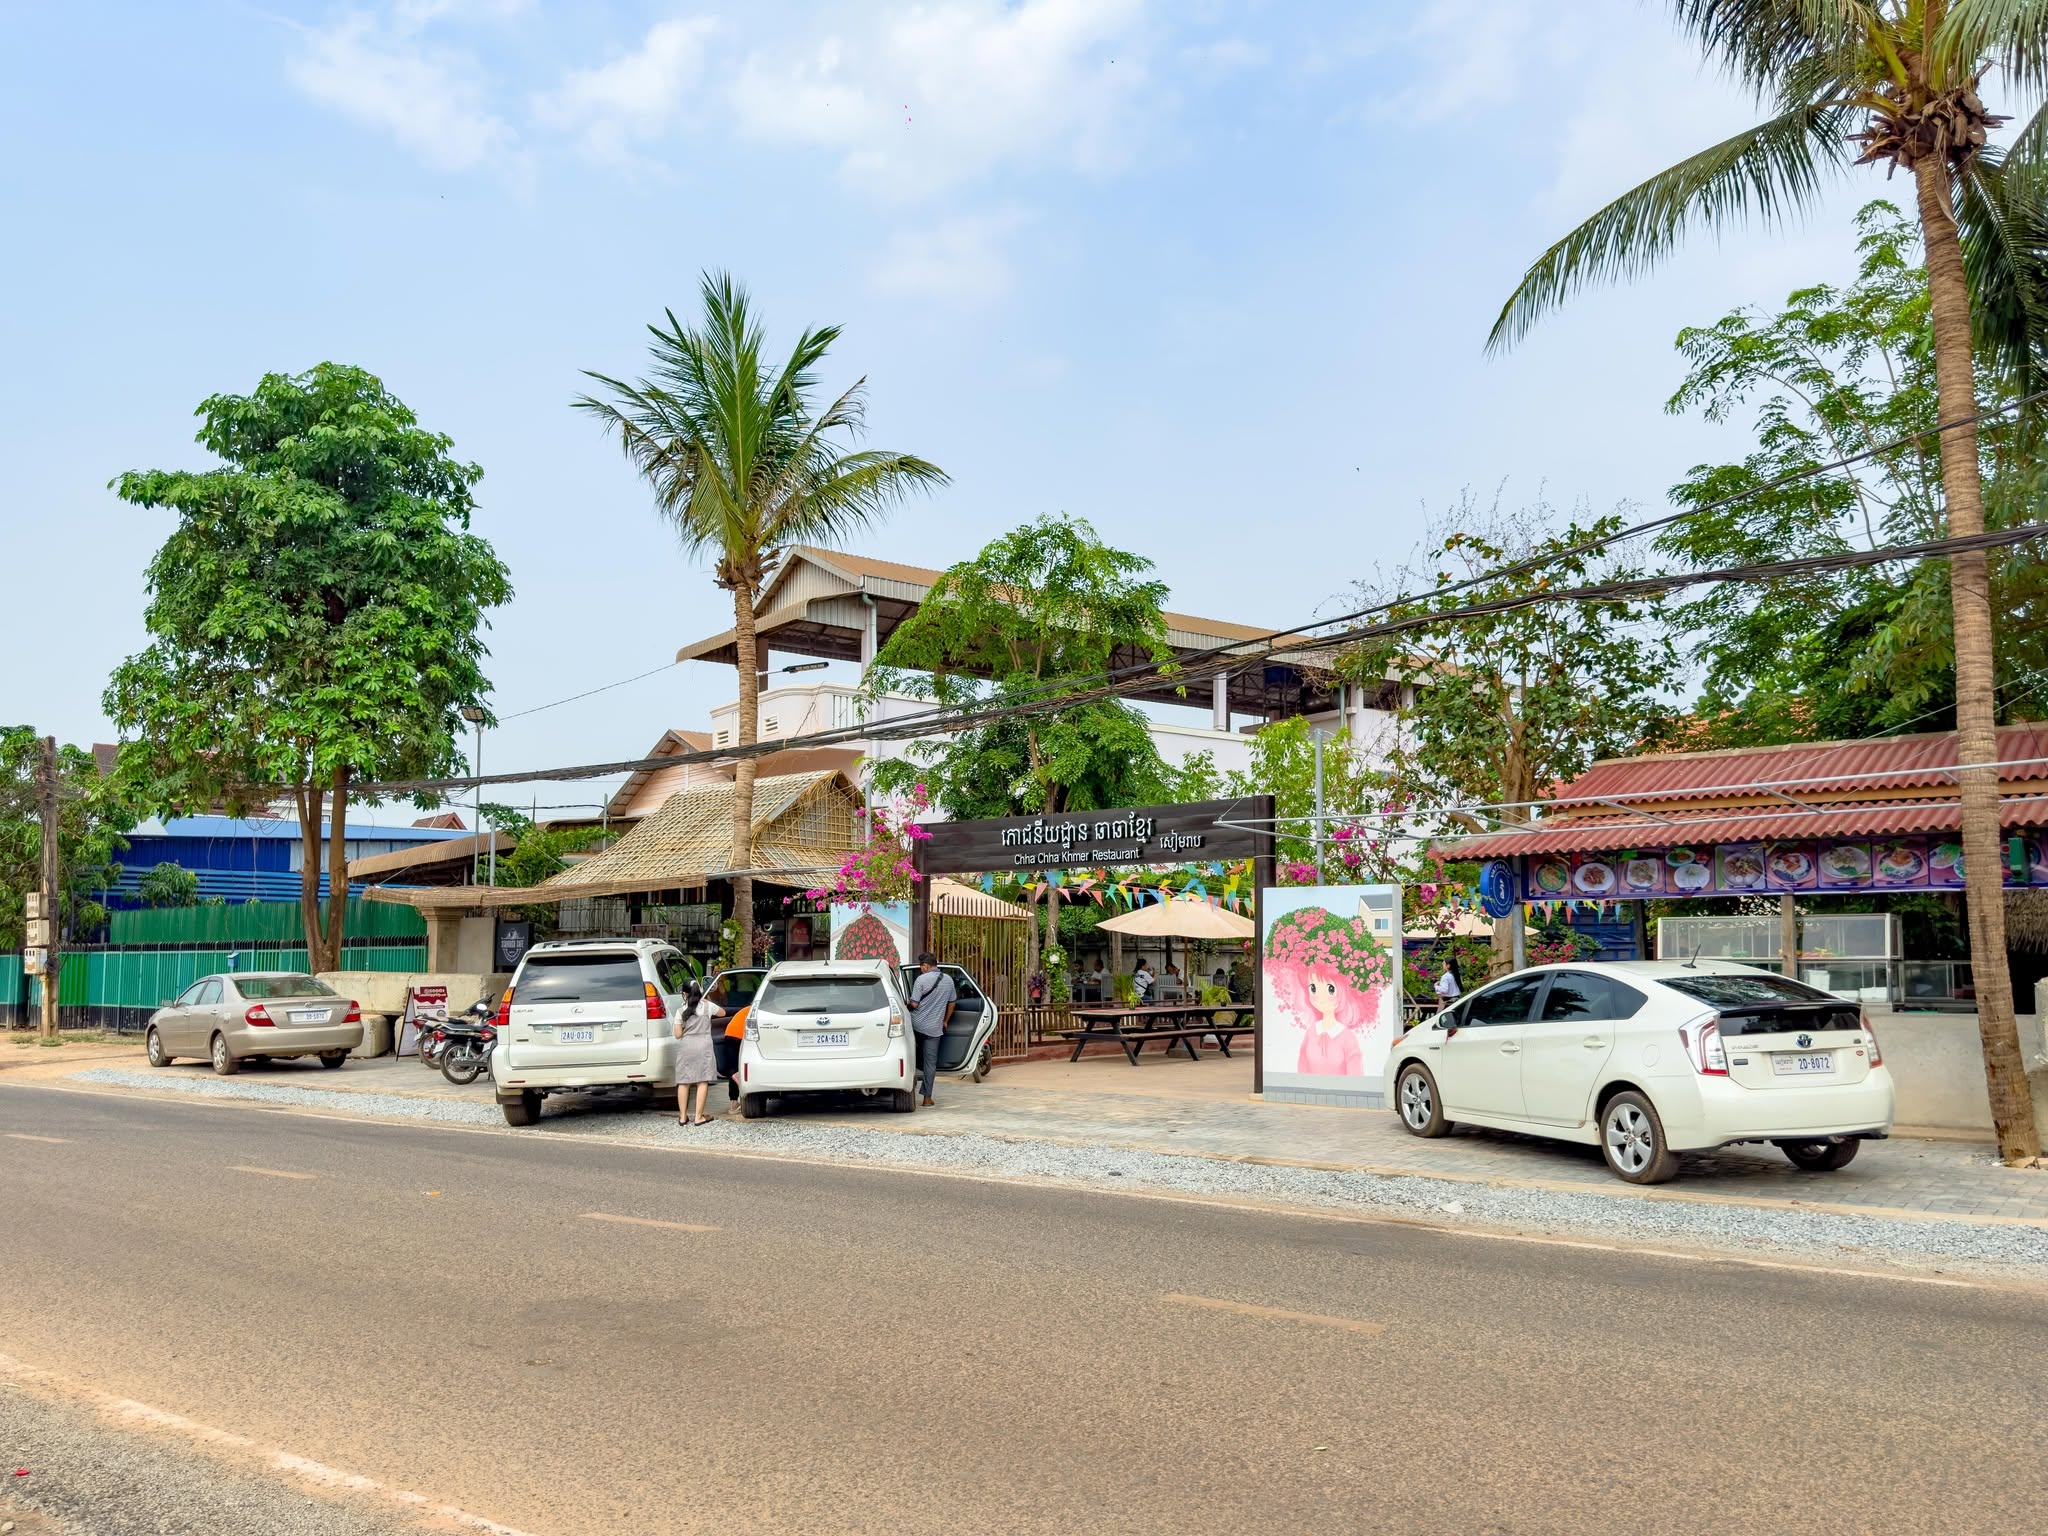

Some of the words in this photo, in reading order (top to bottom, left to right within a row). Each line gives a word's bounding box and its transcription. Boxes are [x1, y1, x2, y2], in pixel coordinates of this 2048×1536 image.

[1014, 853, 1036, 865] Chha
[1037, 852, 1060, 864] Chha
[1061, 851, 1089, 863] Khmer
[1092, 847, 1140, 862] Restaurant
